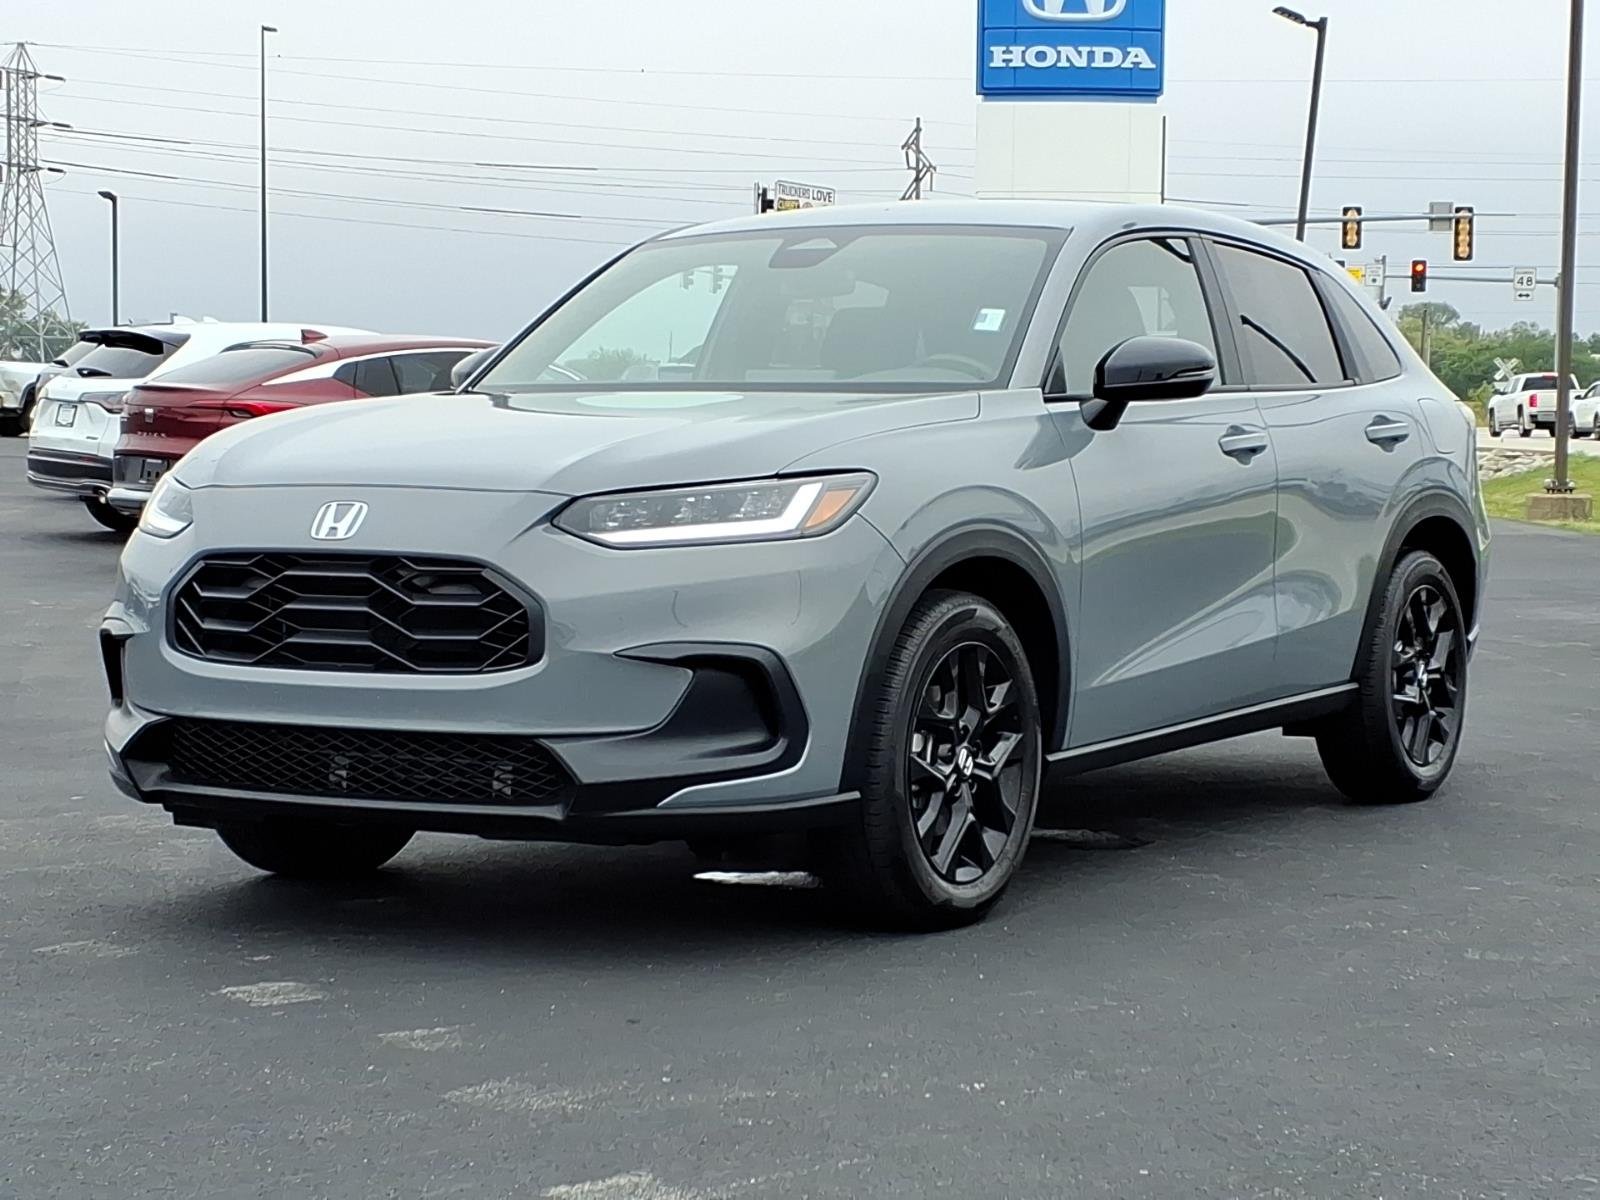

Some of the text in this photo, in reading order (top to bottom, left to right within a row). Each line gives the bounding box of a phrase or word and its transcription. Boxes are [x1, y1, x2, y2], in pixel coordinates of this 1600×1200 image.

[989, 45, 1157, 69] HONDA
[778, 183, 833, 203] TRUCKERS LOVE
[1516, 275, 1533, 287] 48
